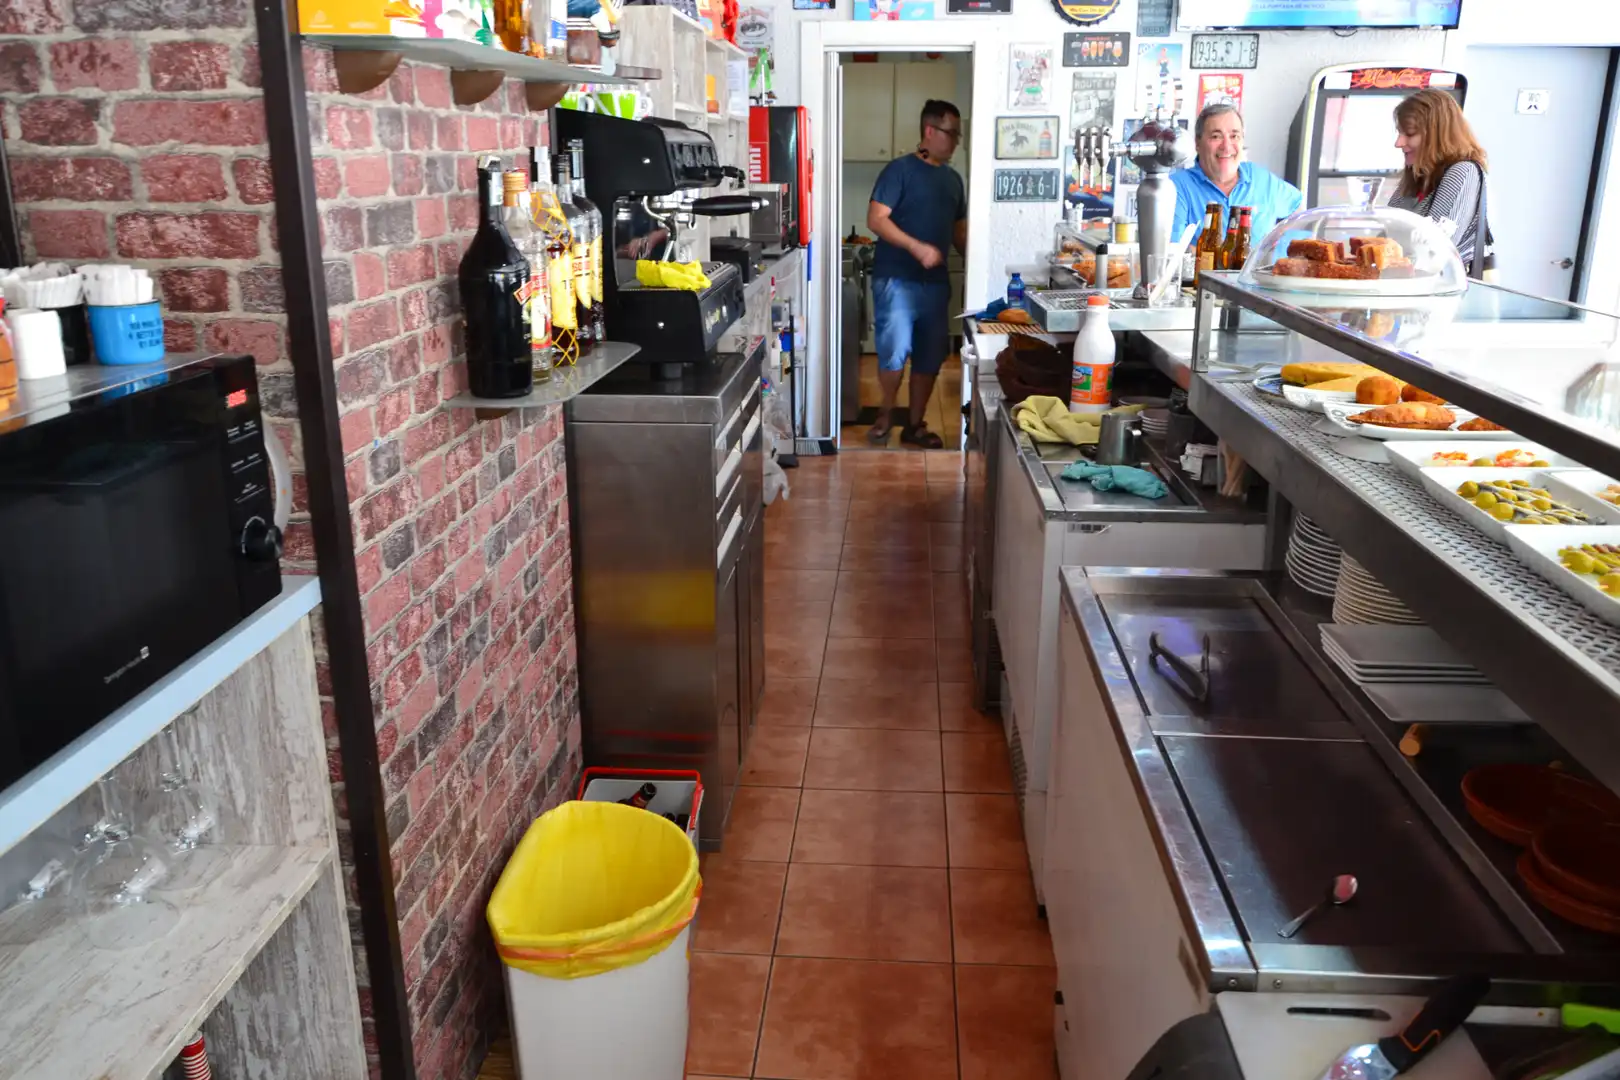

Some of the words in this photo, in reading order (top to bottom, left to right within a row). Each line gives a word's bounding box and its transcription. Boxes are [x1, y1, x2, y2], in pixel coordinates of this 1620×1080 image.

[1194, 41, 1218, 62] 1935
[1075, 79, 1103, 89] ROUTE
[1528, 93, 1541, 102] WC
[749, 147, 761, 181] nini
[998, 175, 1023, 196] 1926
[1038, 175, 1056, 196] 6-1
